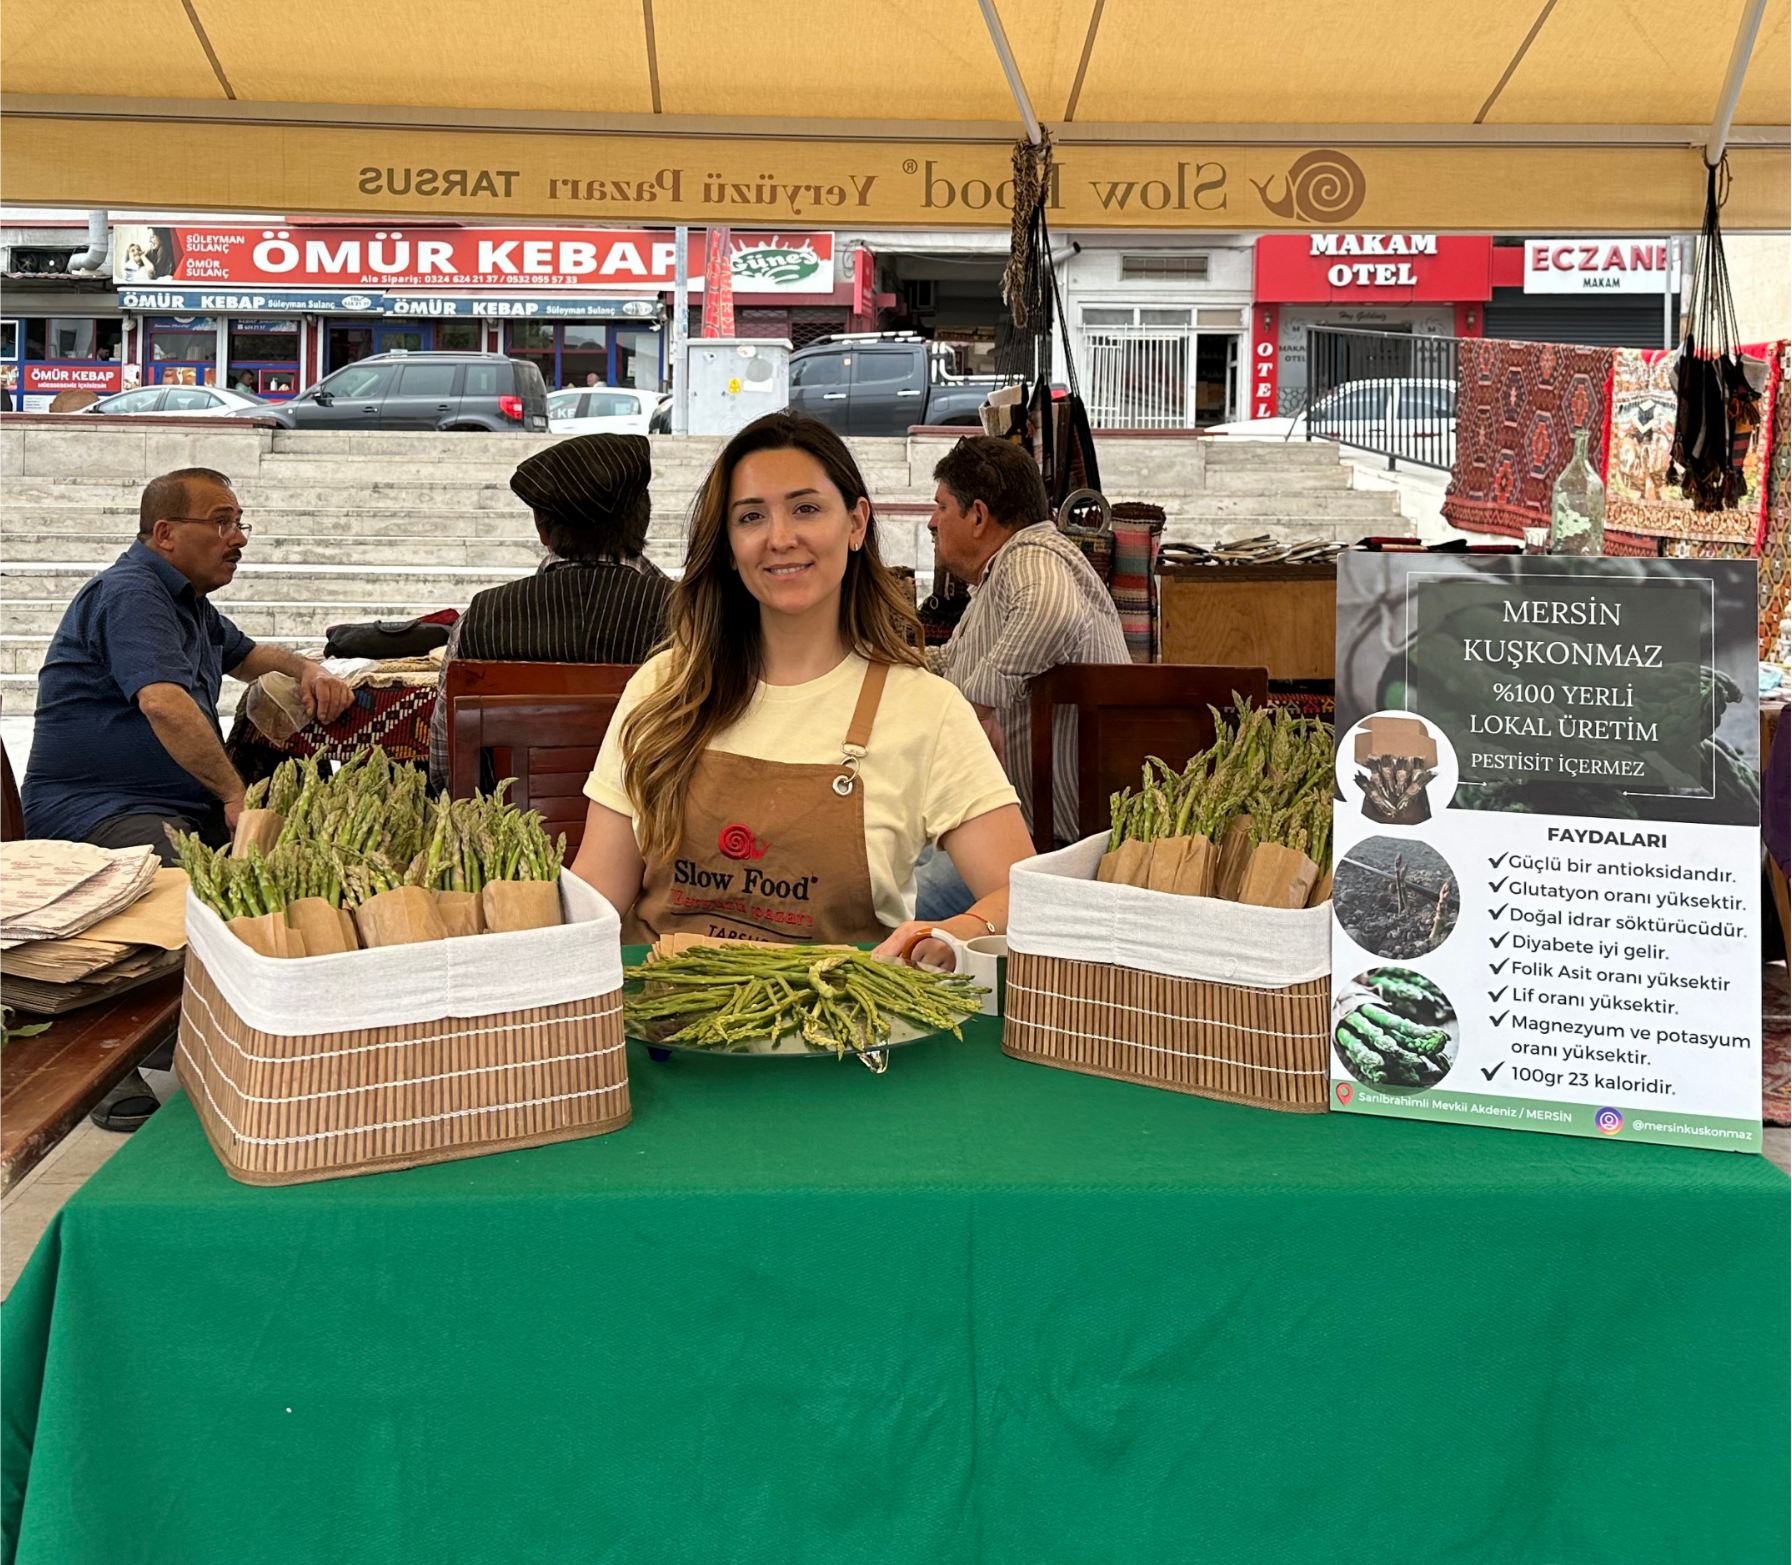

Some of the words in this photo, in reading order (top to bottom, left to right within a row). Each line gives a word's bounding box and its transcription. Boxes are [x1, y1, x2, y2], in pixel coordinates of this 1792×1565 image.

[186, 234, 245, 244] SÜLEYMAN
[186, 244, 229, 254] SULANÇ
[1310, 234, 1437, 256] MAKAM
[186, 259, 220, 268] ÖMÜR
[252, 230, 458, 274] ÖMÜR
[478, 240, 676, 276] KEBAP
[731, 250, 818, 272] Güney
[186, 268, 229, 279] SULANÇ
[361, 275, 378, 283] Alo
[425, 275, 450, 283] 0324
[453, 275, 470, 283] 624
[473, 275, 484, 283] 21
[486, 275, 498, 284] 37
[506, 276, 530, 284] 0532
[532, 276, 550, 284] 055
[551, 276, 564, 284] 57
[566, 276, 578, 284] 33
[1328, 264, 1418, 286] OTEL
[1583, 277, 1620, 288] MAKAM
[123, 292, 185, 309] ÖMÜR
[201, 295, 265, 309] KEBAP
[268, 299, 306, 310] Süleyman
[308, 299, 335, 310] Sulanç
[394, 299, 456, 315] ÖMÜR
[473, 302, 538, 315] KEBAP
[546, 305, 586, 316] Süleyman
[587, 305, 615, 316] Sulanç
[31, 368, 69, 381] ÖMÜR
[72, 371, 114, 381] KEBAP
[1256, 342, 1273, 418] OTEL
[1503, 596, 1622, 627] MERSİN
[1463, 638, 1663, 669] KUŞKONMAZ
[1493, 682, 1555, 705] %100
[1562, 682, 1634, 707] YERLİ
[1470, 715, 1552, 738] LOKAL
[1558, 714, 1658, 742] ÜRETİM
[1470, 752, 1553, 772] PESTİSİT
[1558, 754, 1645, 778] İÇERMEZ
[1547, 827, 1667, 849] FAYDALARI
[674, 859, 734, 891] Slow
[1509, 854, 1561, 874] Güçlü
[1567, 857, 1592, 873] bir
[1596, 861, 1737, 883] antioksidandır.
[1509, 881, 1599, 902] Glutatyon
[1604, 890, 1651, 905] oranı
[1656, 891, 1747, 911] yüksektir.
[1510, 908, 1562, 926] Doğal
[1568, 912, 1611, 928] idrar
[1616, 916, 1748, 938] söktürücüdür.
[1512, 934, 1594, 954] Diyabete
[1599, 941, 1619, 957] iyi
[1624, 943, 1670, 960] gelir.
[1512, 961, 1553, 977] Folik
[1558, 965, 1592, 981] Asit
[1596, 971, 1642, 985] oranı
[1647, 973, 1731, 991] yüksektir
[1513, 987, 1534, 1002] Lif
[1538, 992, 1585, 1007] oranı
[1589, 994, 1679, 1015] yüksektir.
[1512, 1014, 1625, 1038] Magnezyum
[1630, 1027, 1651, 1040] ve
[1656, 1029, 1751, 1049] potasyum
[1511, 1042, 1557, 1056] oranı
[1562, 1045, 1651, 1065] yüksektir.
[1511, 1066, 1563, 1087] 100gr
[1568, 1071, 1589, 1087] 23
[1594, 1073, 1676, 1095] kaloridir.
[1432, 1099, 1468, 1113] Mevkii
[1470, 1103, 1517, 1118] Akdeniz
[1526, 1108, 1572, 1123] MERSİN
[1632, 1119, 1753, 1140] @mersinkuskonmaz
